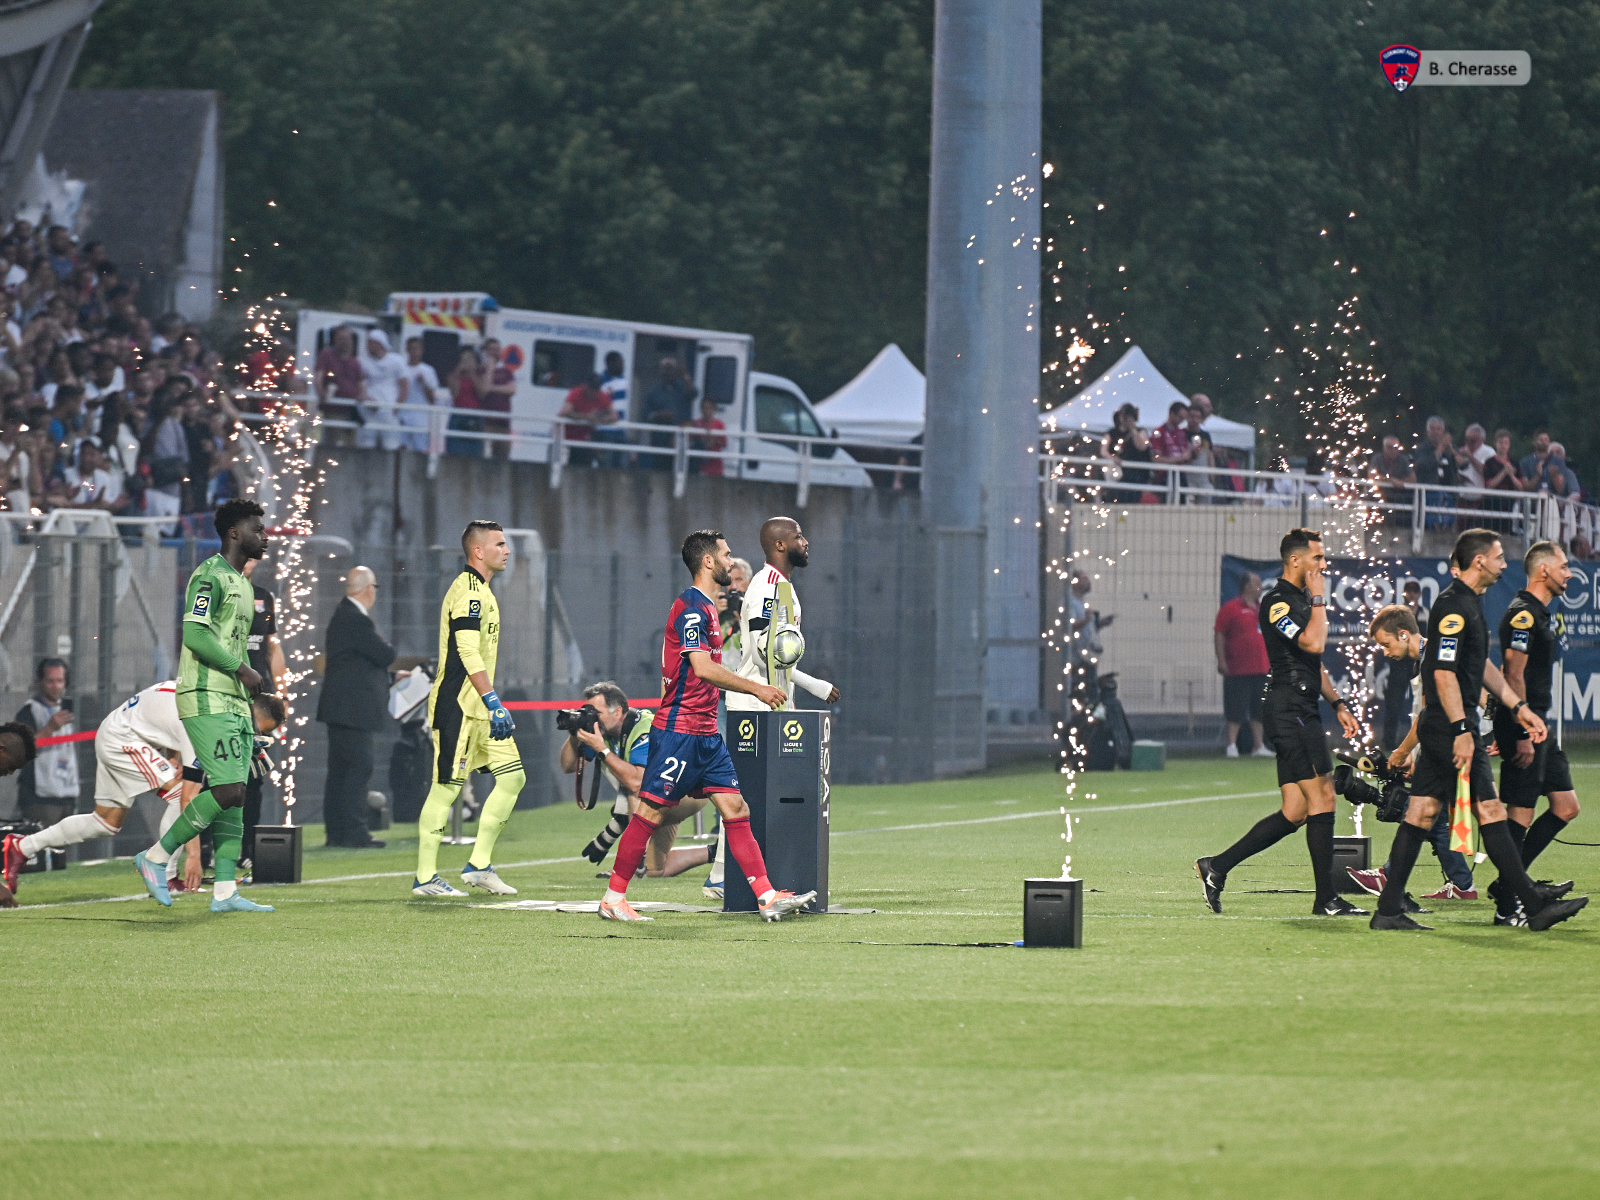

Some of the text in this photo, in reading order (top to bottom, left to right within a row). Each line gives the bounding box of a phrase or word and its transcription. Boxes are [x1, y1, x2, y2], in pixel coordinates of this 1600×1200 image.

[141, 746, 160, 763] 2
[214, 737, 241, 762] 40
[660, 756, 688, 783] 21
